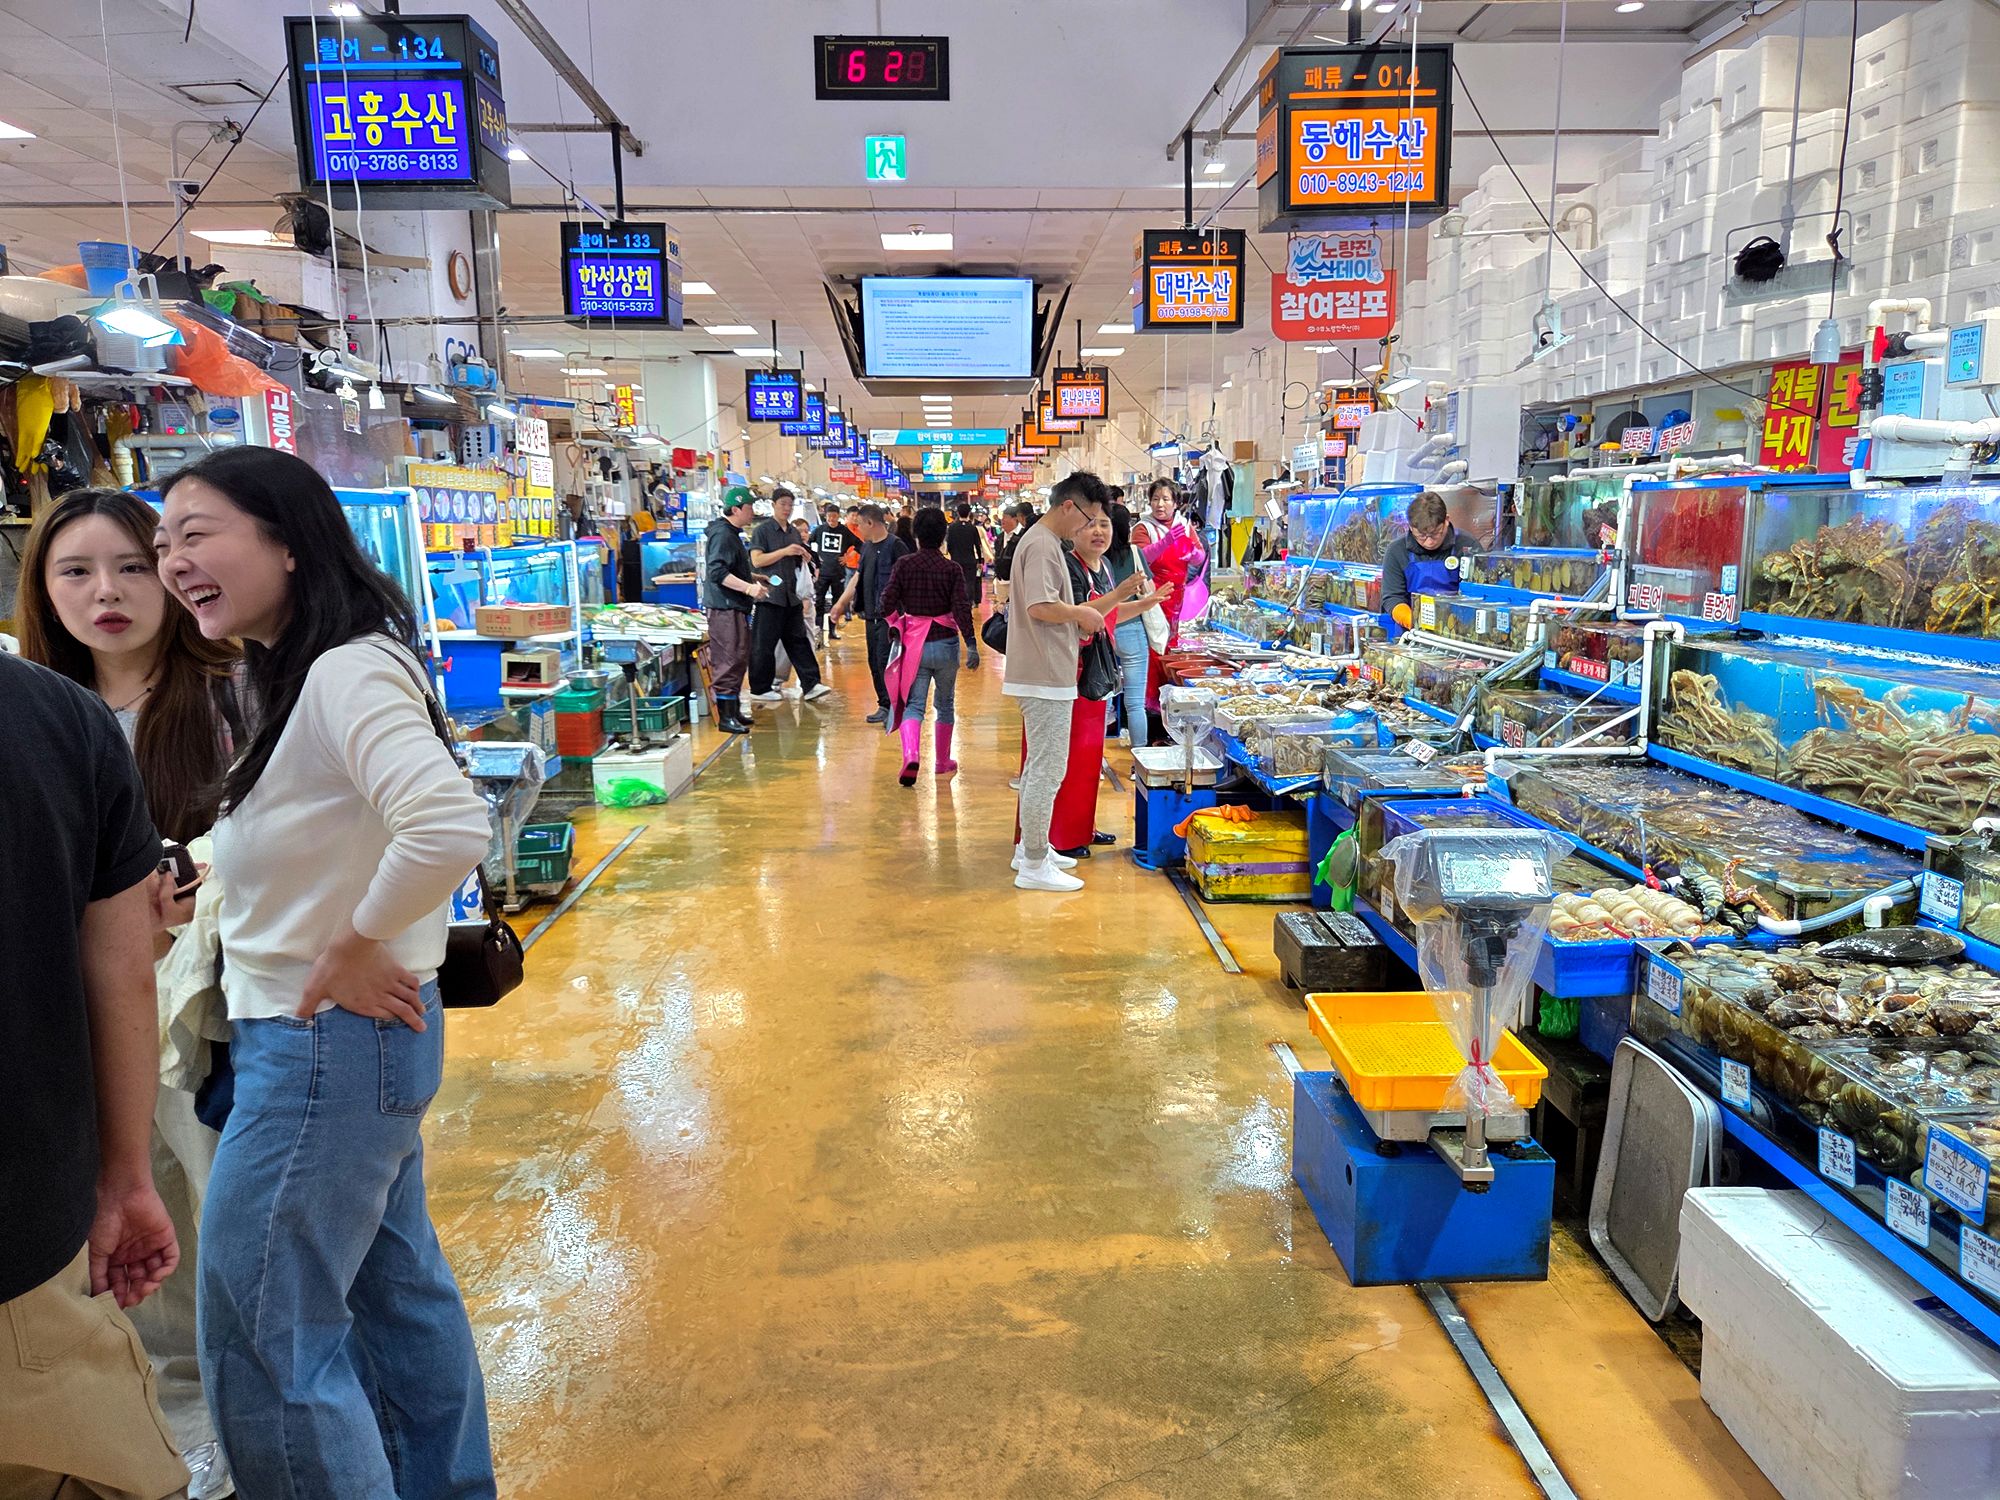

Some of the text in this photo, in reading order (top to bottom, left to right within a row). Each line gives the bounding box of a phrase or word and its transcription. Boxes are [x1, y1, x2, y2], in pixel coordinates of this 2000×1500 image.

[319, 38, 360, 61] 활어
[399, 37, 444, 60] 134
[847, 50, 904, 83] 6 2
[1304, 66, 1343, 90] 패류
[1378, 65, 1420, 88] 014
[324, 90, 457, 147] 고흥수산
[1301, 119, 1428, 163] 동해수산
[329, 152, 459, 172] 010-3786-8133
[1299, 171, 1425, 194] 010-8943-1244
[623, 234, 651, 248] 133
[1321, 240, 1371, 259] 노량진
[578, 265, 653, 297] 한성상회
[1295, 256, 1372, 280] 수산데이
[1155, 271, 1232, 304] 대박수산
[580, 301, 655, 312] 010-3015-5373
[1280, 291, 1388, 321] 참여점포
[754, 391, 795, 409] 목포항
[1771, 366, 1820, 411] 전복
[1622, 430, 1652, 453] 완도전복
[1659, 423, 1696, 450] 돌문어
[1764, 416, 1811, 459] 낙지
[1627, 583, 1663, 611] 피문어
[1703, 592, 1736, 624] 돌멍게
[1502, 717, 1525, 749] 해삼
